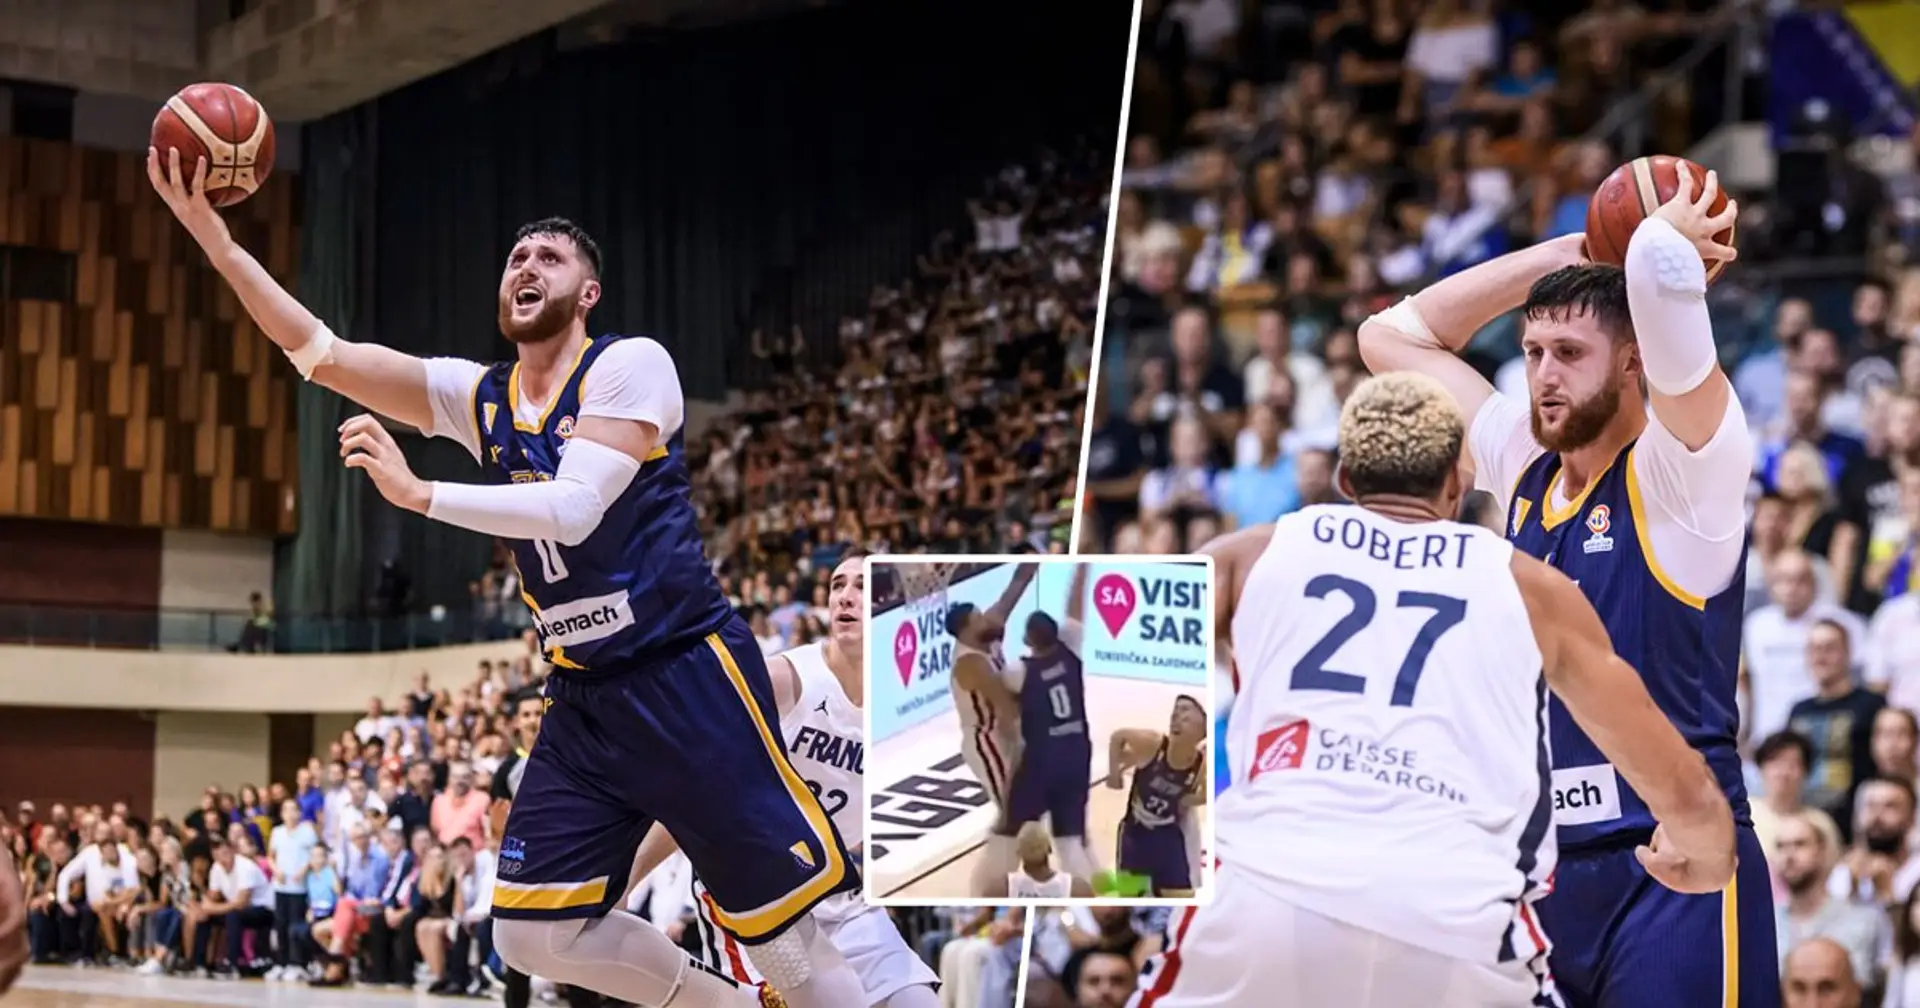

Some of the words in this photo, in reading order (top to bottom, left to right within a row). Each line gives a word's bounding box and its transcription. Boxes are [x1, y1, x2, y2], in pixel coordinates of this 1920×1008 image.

[1313, 513, 1474, 570] GOBERT
[1101, 585, 1128, 607] SA
[1139, 576, 1207, 610] VISI
[917, 608, 945, 644] VIS
[1139, 614, 1204, 647] SAR
[1289, 573, 1468, 708] 27
[919, 642, 951, 681] SAR
[1048, 683, 1072, 720] 0
[1319, 728, 1418, 769] CAISSE
[805, 780, 849, 816] 2
[1555, 781, 1602, 810] ach
